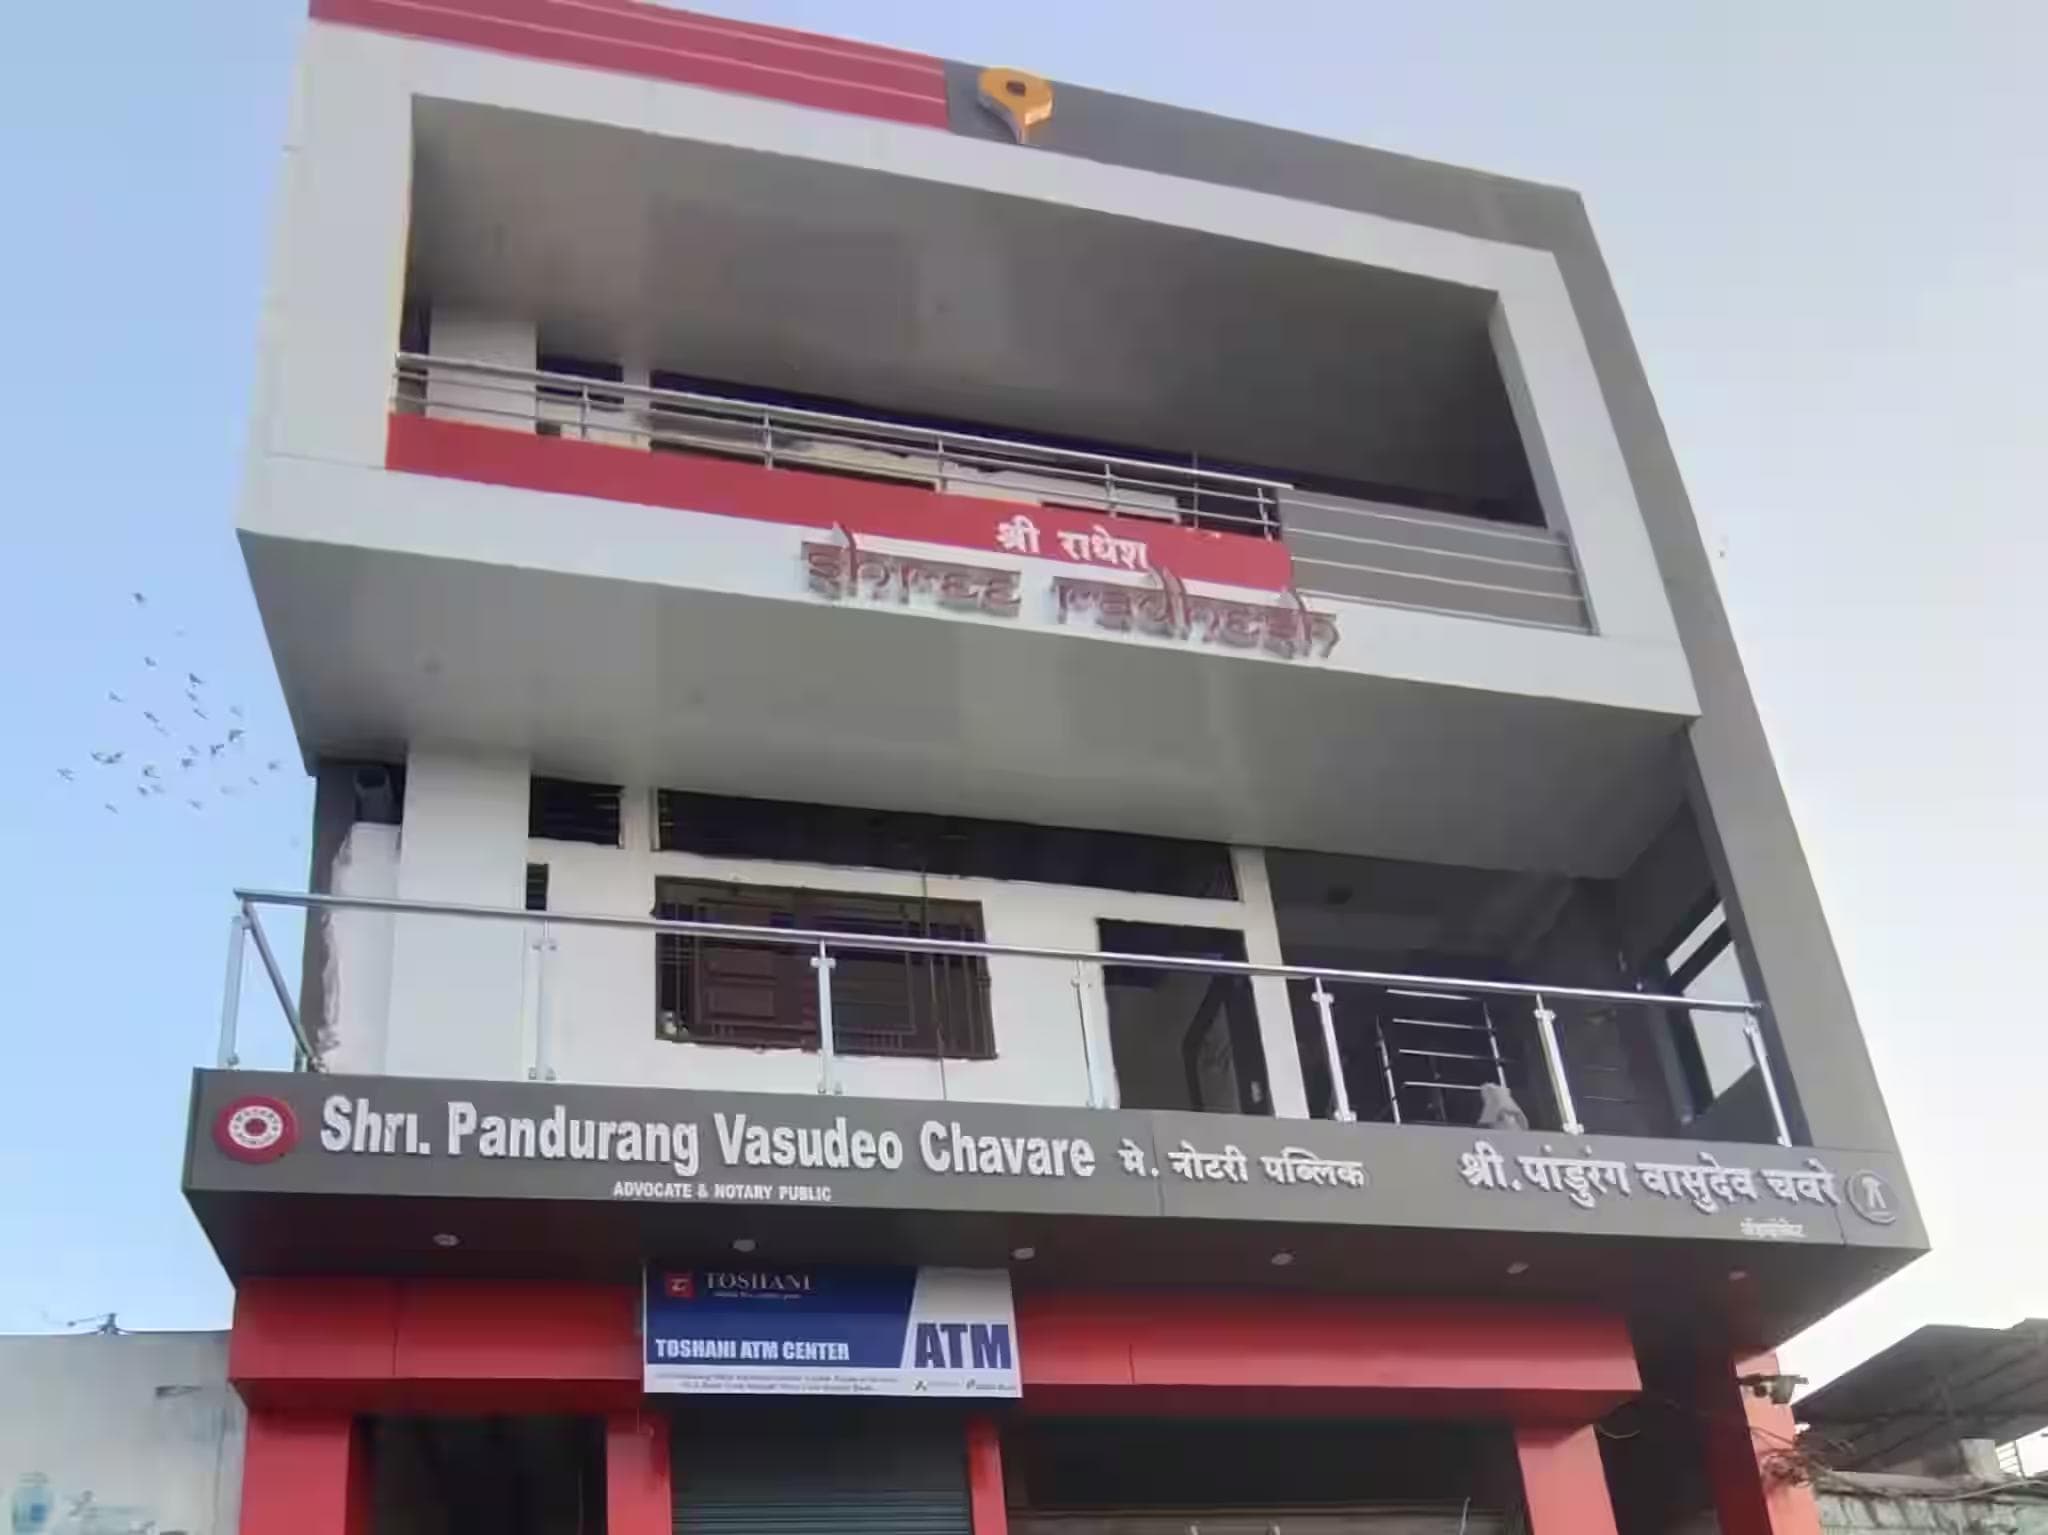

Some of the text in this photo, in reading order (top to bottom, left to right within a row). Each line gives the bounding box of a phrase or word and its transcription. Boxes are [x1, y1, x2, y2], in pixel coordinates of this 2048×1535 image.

[994, 514, 1151, 570] श्री राधेश
[447, 1101, 698, 1176] Pandurang
[713, 1112, 904, 1169] Vasudeo
[920, 1120, 1097, 1177] Chavare
[1167, 1140, 1249, 1182] नोटरी
[1259, 1146, 1365, 1187] पब्लिक
[1634, 1151, 1759, 1214] वासुदेव
[1760, 1157, 1842, 1205] चवरे
[613, 1181, 833, 1202] ADVOCATE & NOTARY PUBLIC
[705, 1271, 814, 1292] TOSHANI
[655, 1338, 851, 1361] TOSHANI ATM CENTER
[913, 1323, 1014, 1370] ATM
